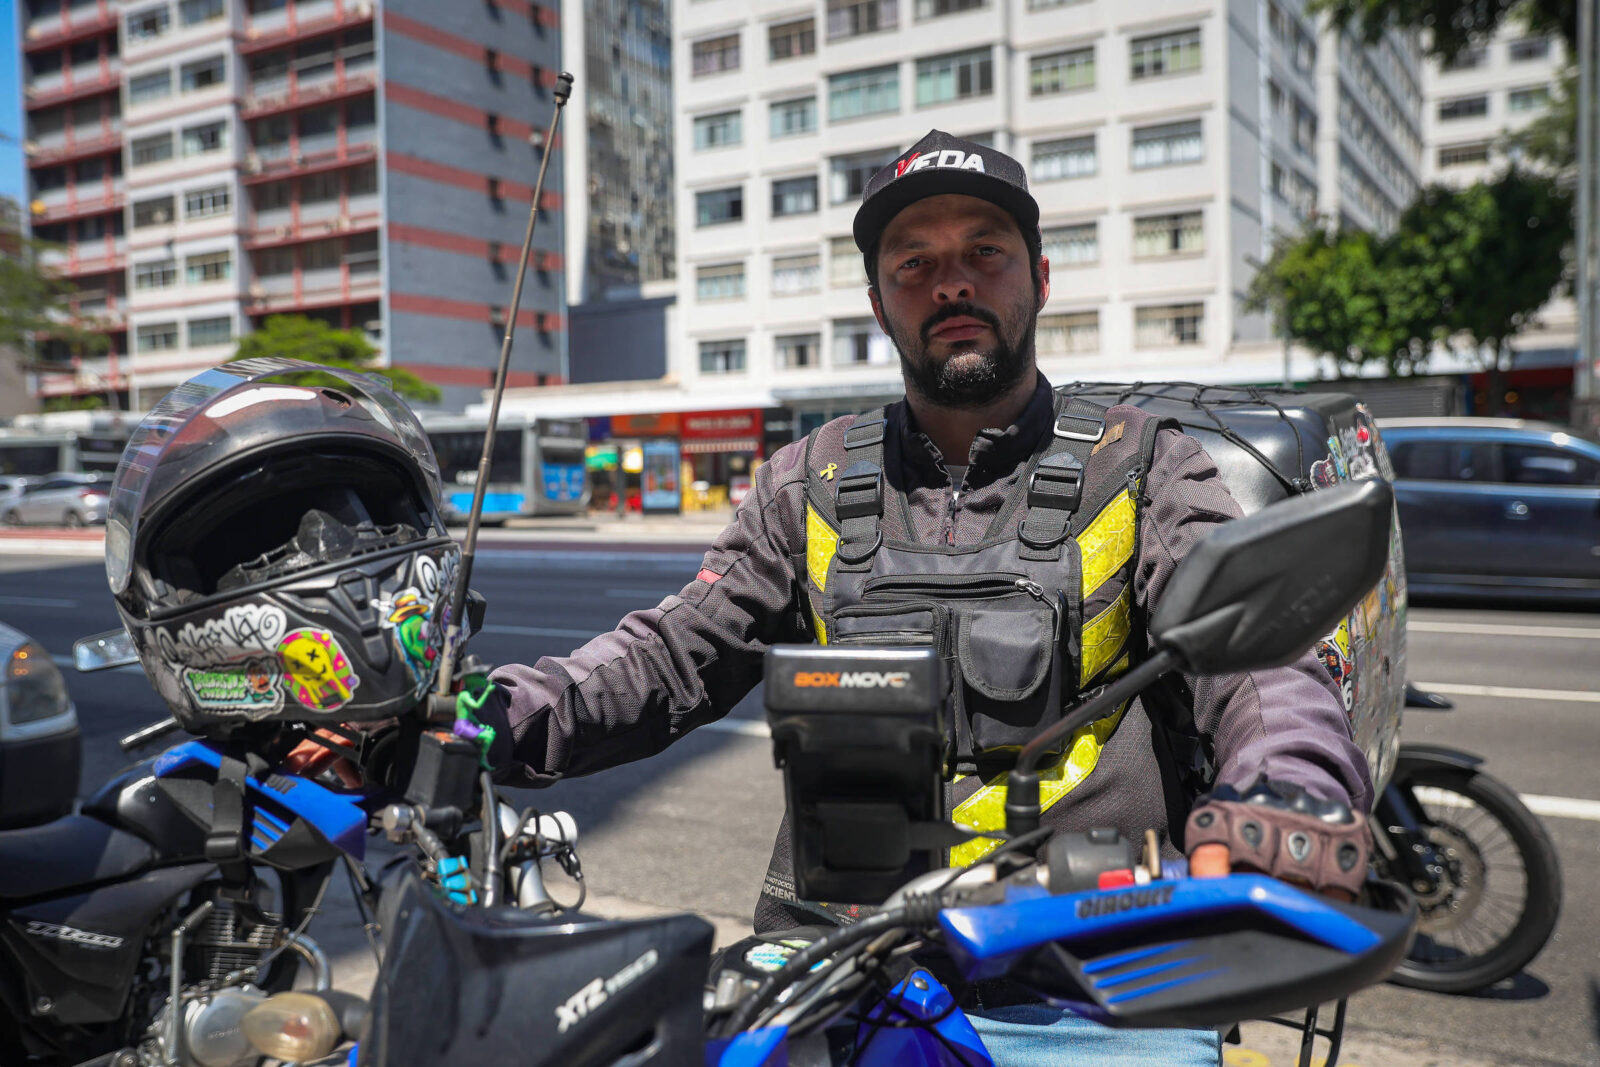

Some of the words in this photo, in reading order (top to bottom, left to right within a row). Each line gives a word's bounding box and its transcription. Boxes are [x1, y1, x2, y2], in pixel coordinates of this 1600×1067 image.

[894, 150, 985, 179] VEDA
[794, 671, 911, 688] BOXMOVE
[763, 883, 801, 904] SCIENT
